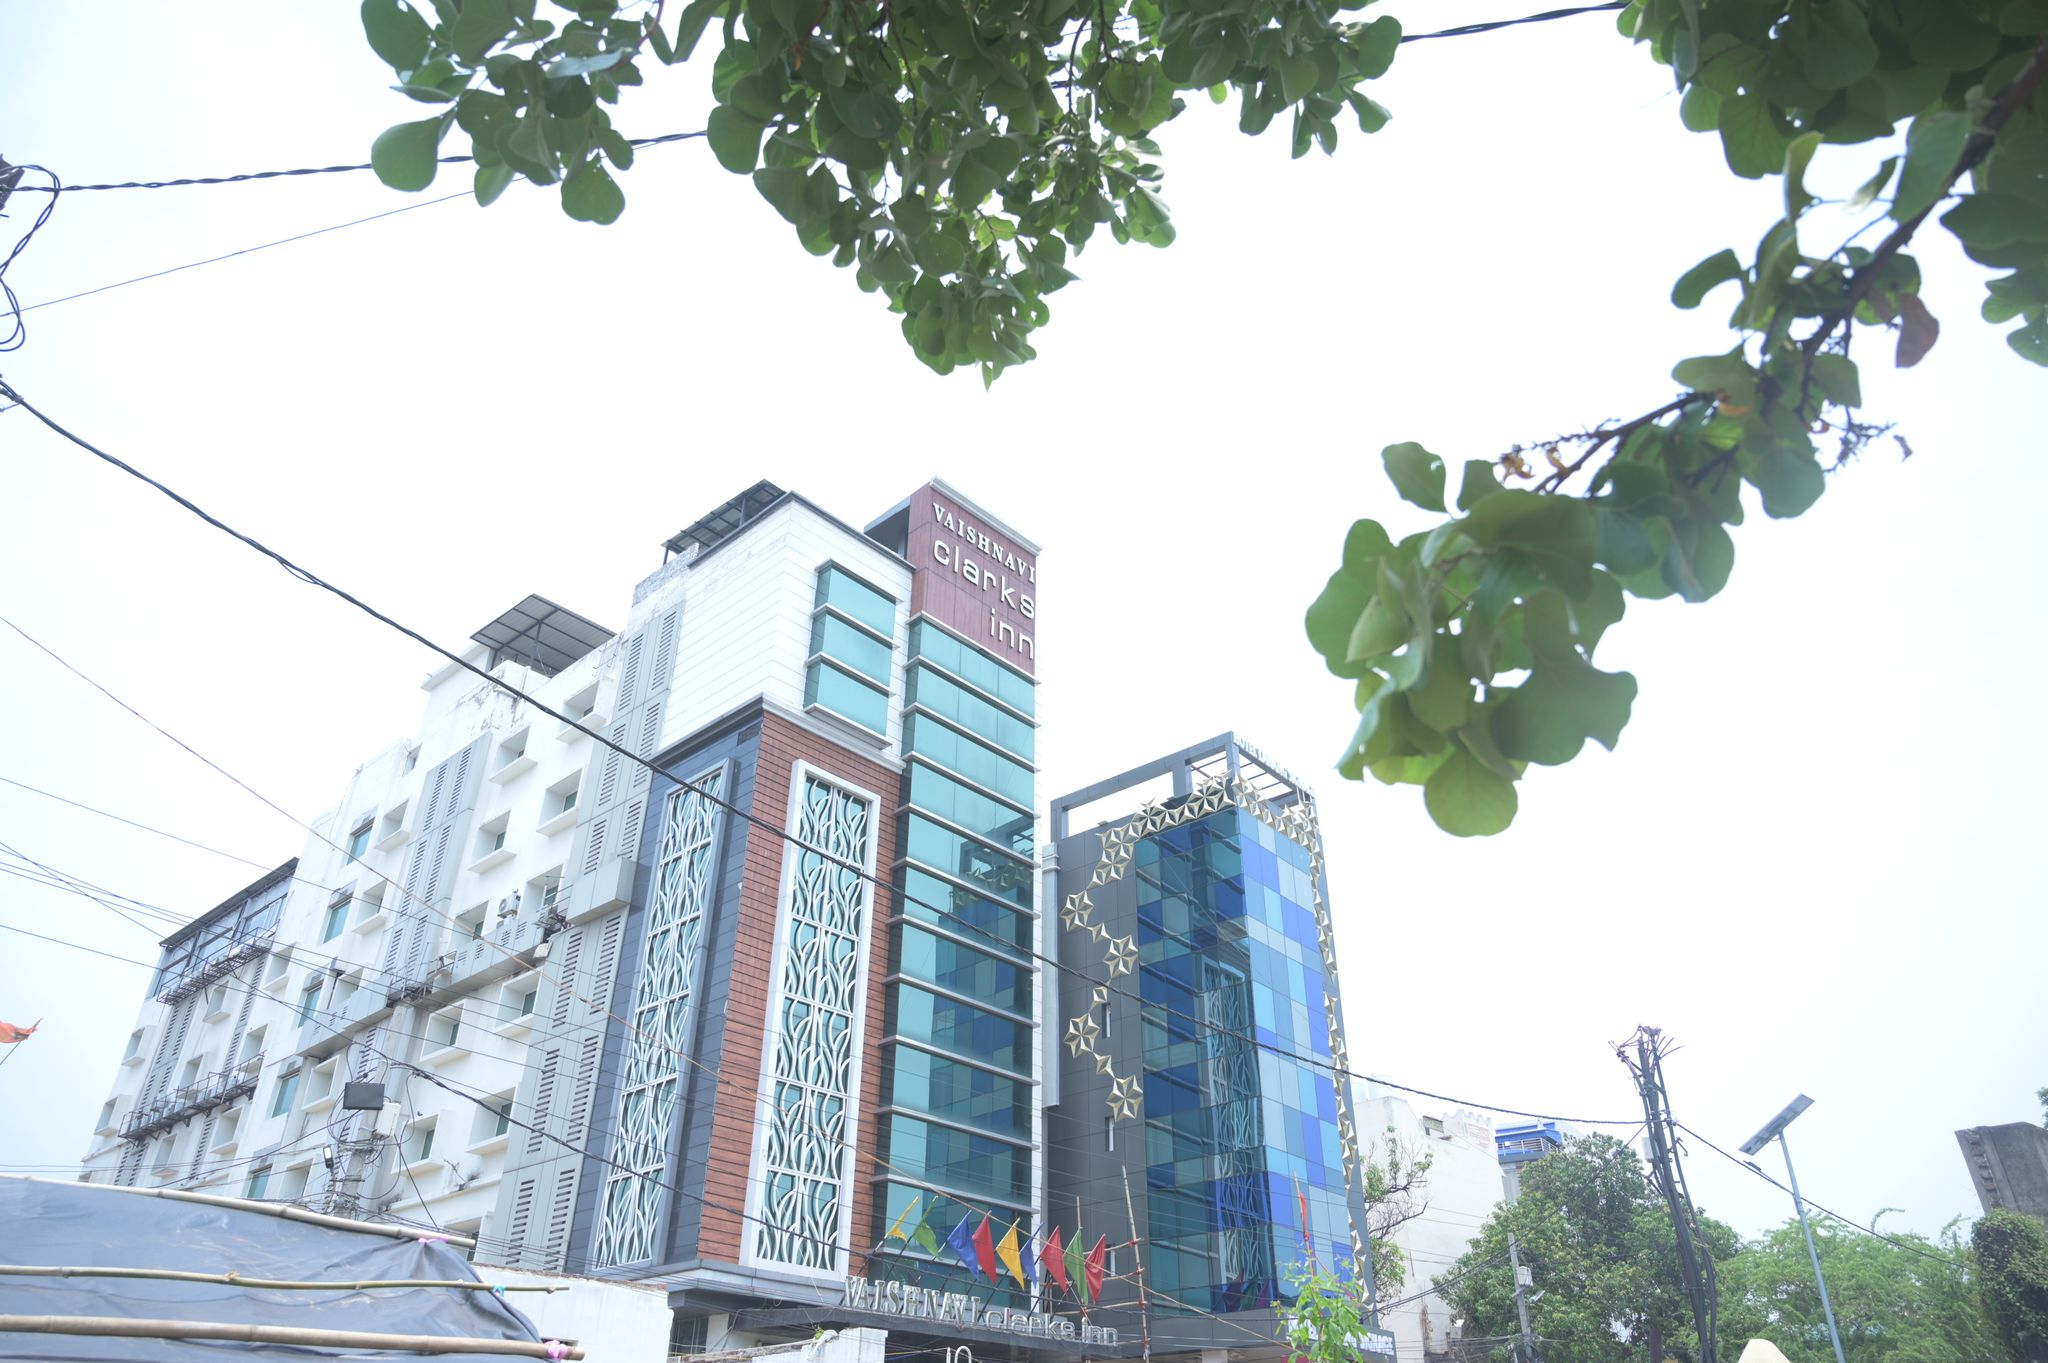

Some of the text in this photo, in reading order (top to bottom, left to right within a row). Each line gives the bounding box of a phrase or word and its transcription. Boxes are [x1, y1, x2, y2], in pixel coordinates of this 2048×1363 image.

[933, 503, 1036, 583] VAISHNAVI
[990, 607, 1034, 659] inn
[846, 1275, 980, 1328] VAISHNAVI
